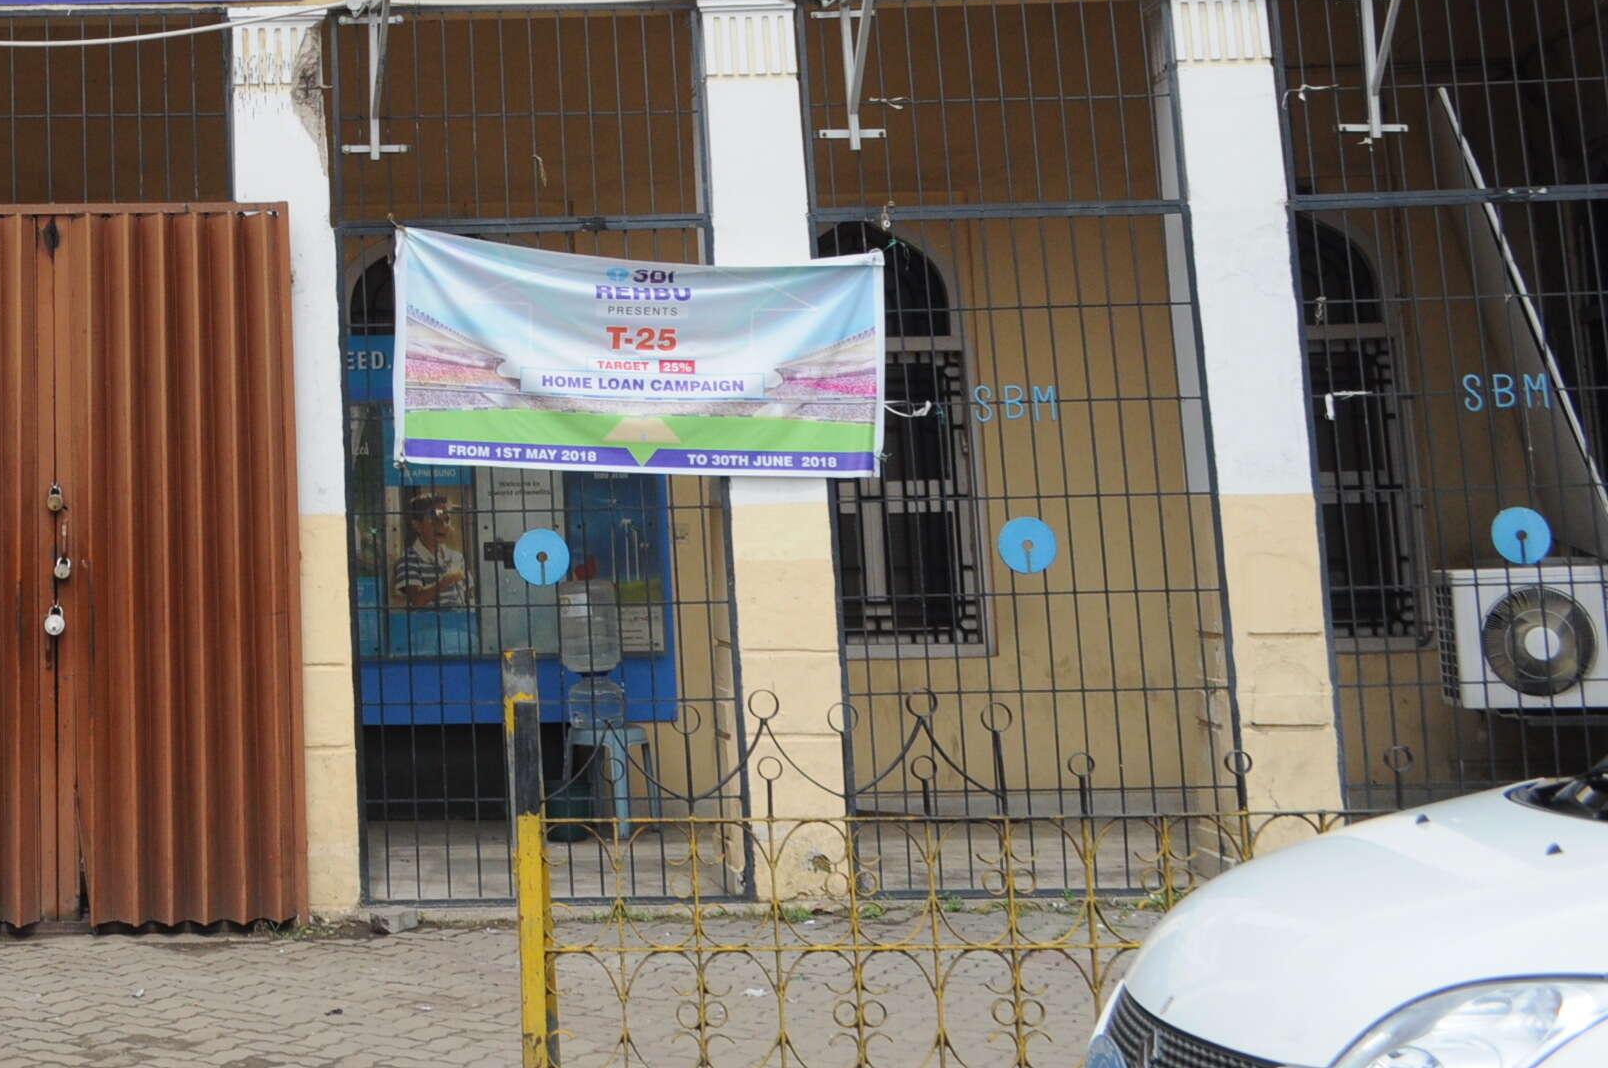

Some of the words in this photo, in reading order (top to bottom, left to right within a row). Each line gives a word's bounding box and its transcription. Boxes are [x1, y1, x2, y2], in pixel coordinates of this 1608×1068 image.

[596, 285, 692, 301] REHBU
[608, 306, 678, 316] PRESENTS
[606, 326, 677, 351] T-25
[597, 361, 649, 371] TARGET
[663, 363, 692, 372] 25%
[542, 375, 592, 389] HOME
[599, 378, 644, 390] LOAN
[650, 380, 744, 392] CAMPAIGN
[1462, 372, 1551, 413] SBM
[974, 385, 1058, 422] SBM
[448, 444, 490, 457] FROM
[494, 446, 522, 460] 1ST
[525, 448, 557, 461] MAY
[561, 450, 597, 462] 2018
[687, 454, 708, 465] TO
[711, 454, 750, 467] 30TH
[753, 455, 792, 467] JUNE
[801, 456, 838, 468] 2018
